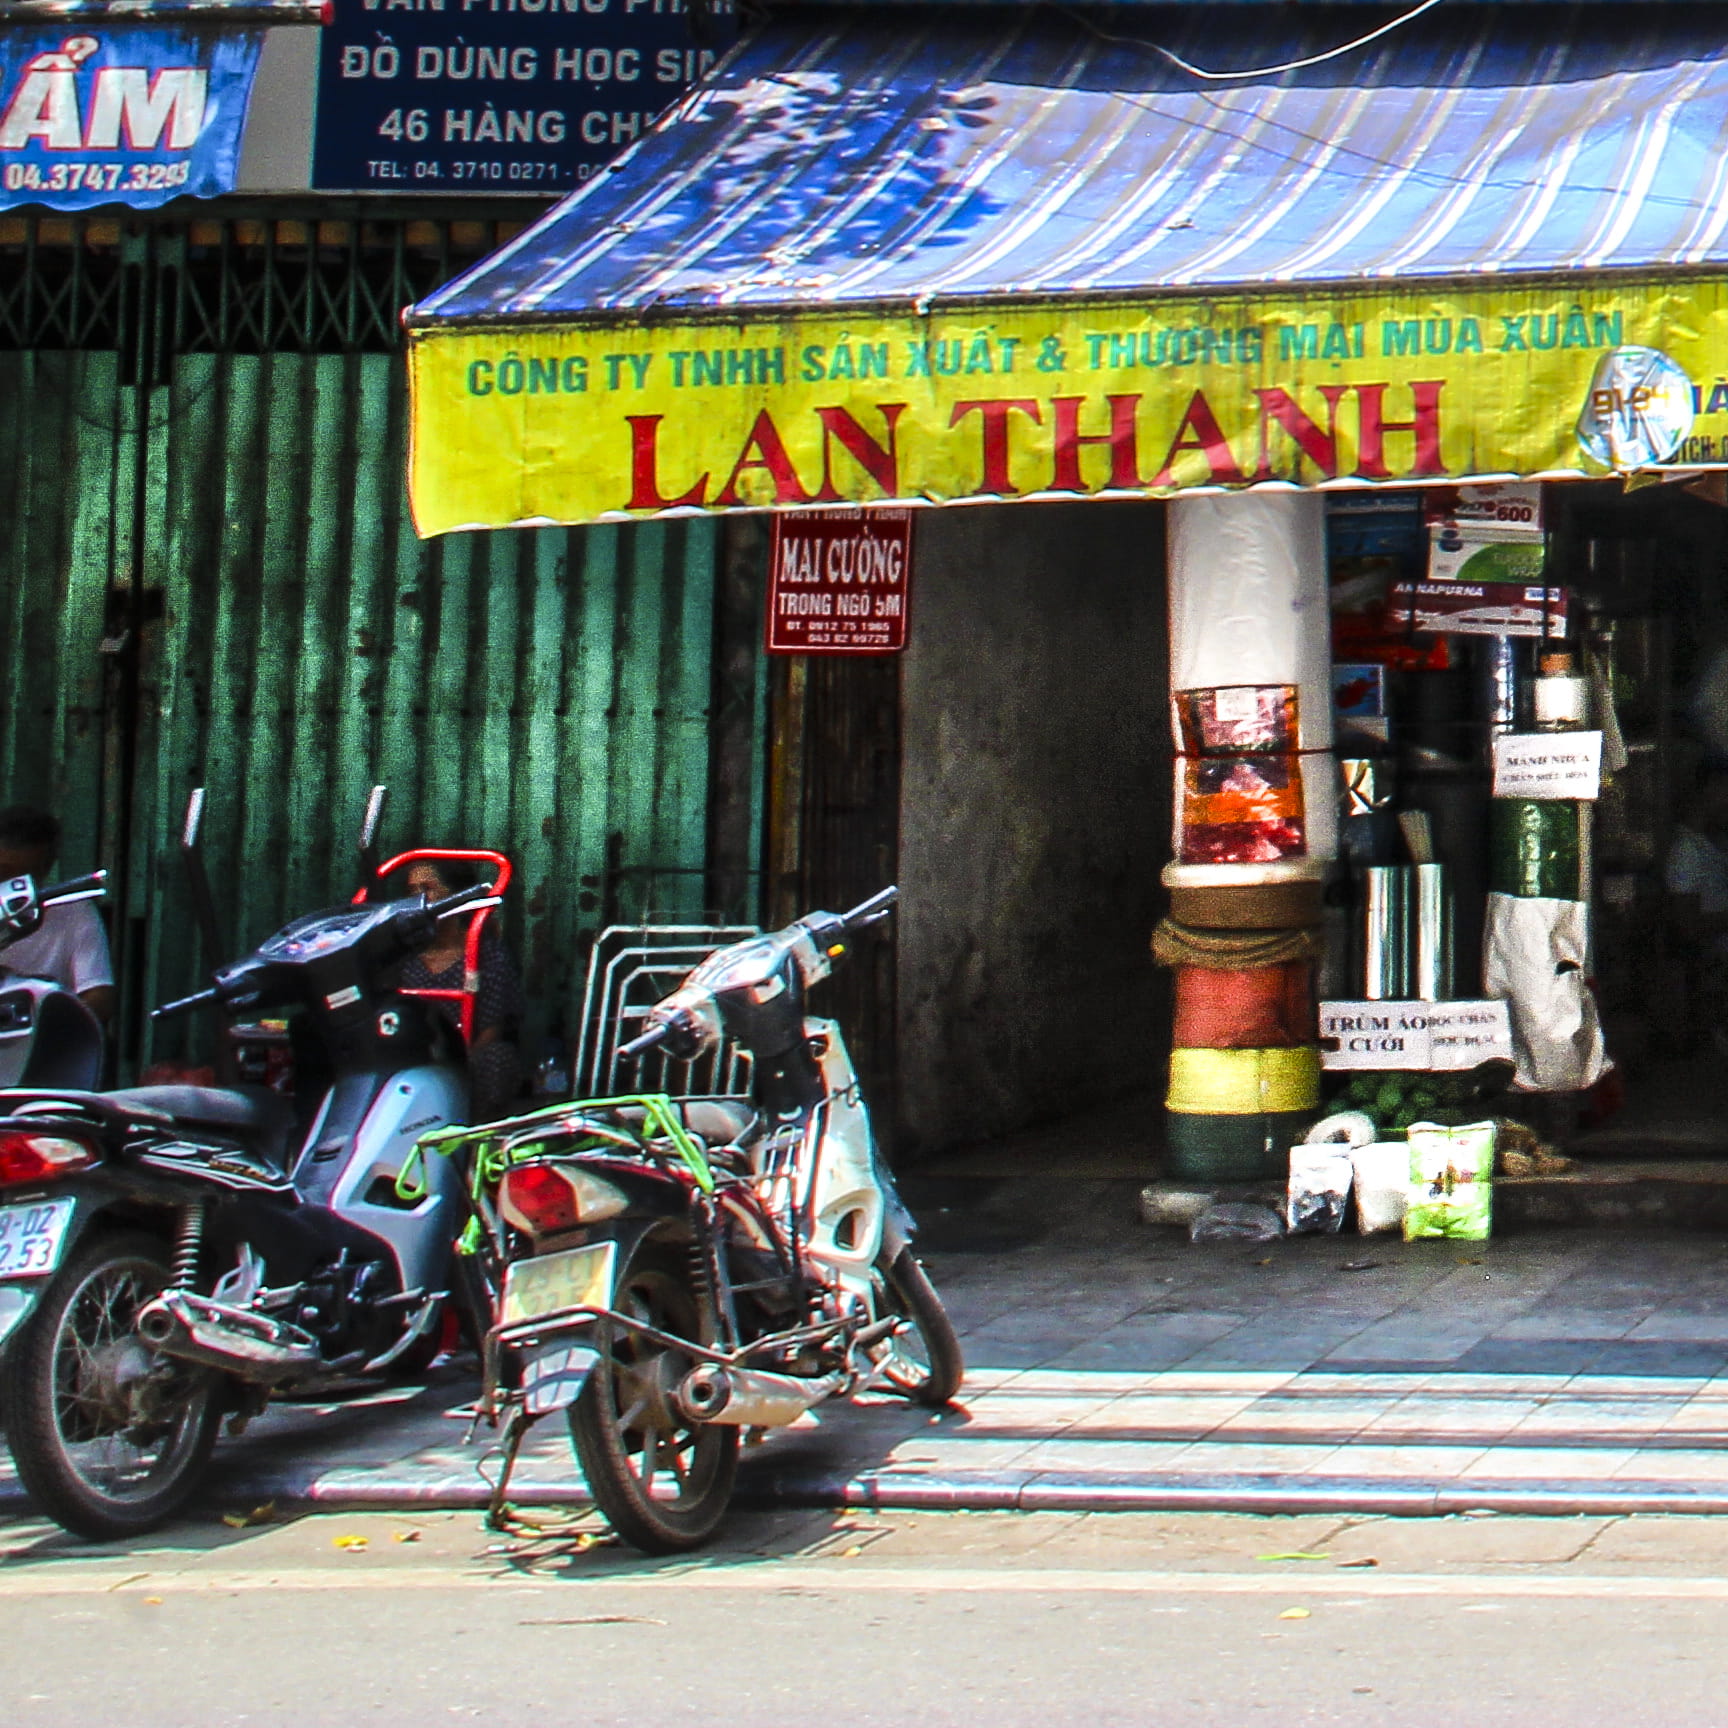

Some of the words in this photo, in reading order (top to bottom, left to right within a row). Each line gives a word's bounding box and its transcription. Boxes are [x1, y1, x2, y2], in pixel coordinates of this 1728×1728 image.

[341, 30, 400, 79] ĐỒ
[415, 35, 539, 80] DÙNG
[552, 48, 641, 92] HỌC
[379, 108, 430, 143] 46
[443, 101, 567, 144] HÀNG
[368, 160, 405, 180] TEL:
[413, 160, 446, 180] 04.
[452, 160, 501, 181] 3710
[509, 160, 558, 181] 0271
[468, 351, 590, 397] CÔNG
[603, 352, 653, 391] TY
[668, 347, 786, 387] TNHH
[800, 330, 888, 383] SẢN
[906, 324, 1021, 378] XUẤT
[1035, 334, 1067, 374] &
[1084, 324, 1263, 370] THƯƠNG
[1279, 321, 1366, 368] MẠI
[1382, 309, 1484, 358] MÙA
[1499, 303, 1624, 353] XUÂN
[624, 402, 909, 511] LAN
[947, 379, 1449, 495] THANH
[779, 536, 824, 584] MAI
[826, 525, 903, 584] CƯỜNG
[778, 592, 832, 616] TRONG
